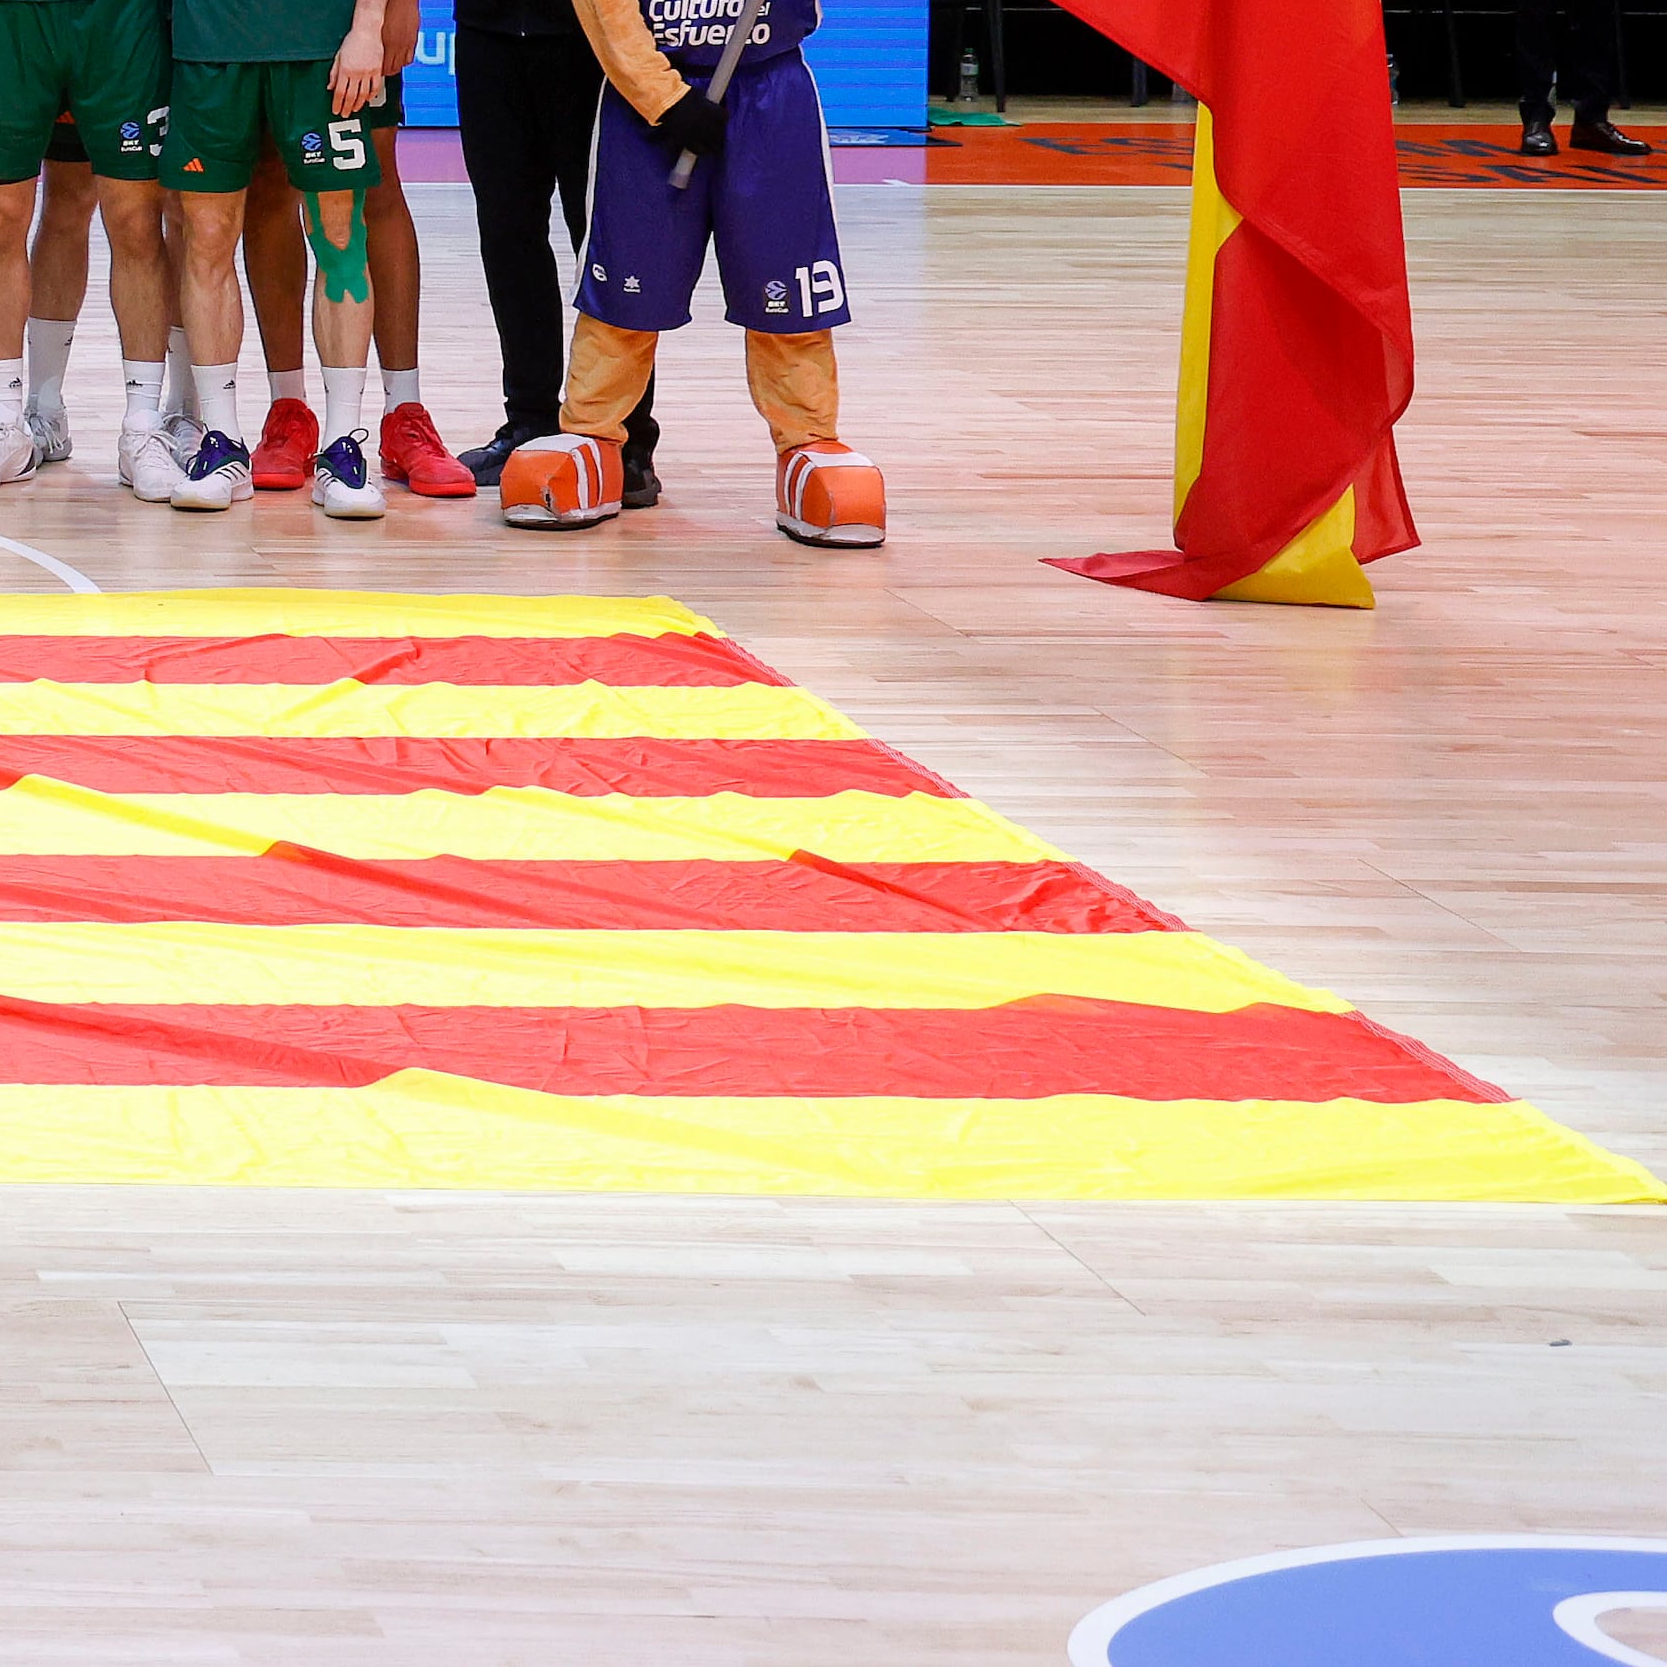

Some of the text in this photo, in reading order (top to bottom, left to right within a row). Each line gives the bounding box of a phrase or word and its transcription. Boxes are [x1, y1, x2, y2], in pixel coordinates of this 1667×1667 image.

[756, 1, 771, 16] el
[329, 120, 366, 170] 5
[795, 261, 844, 318] 19
